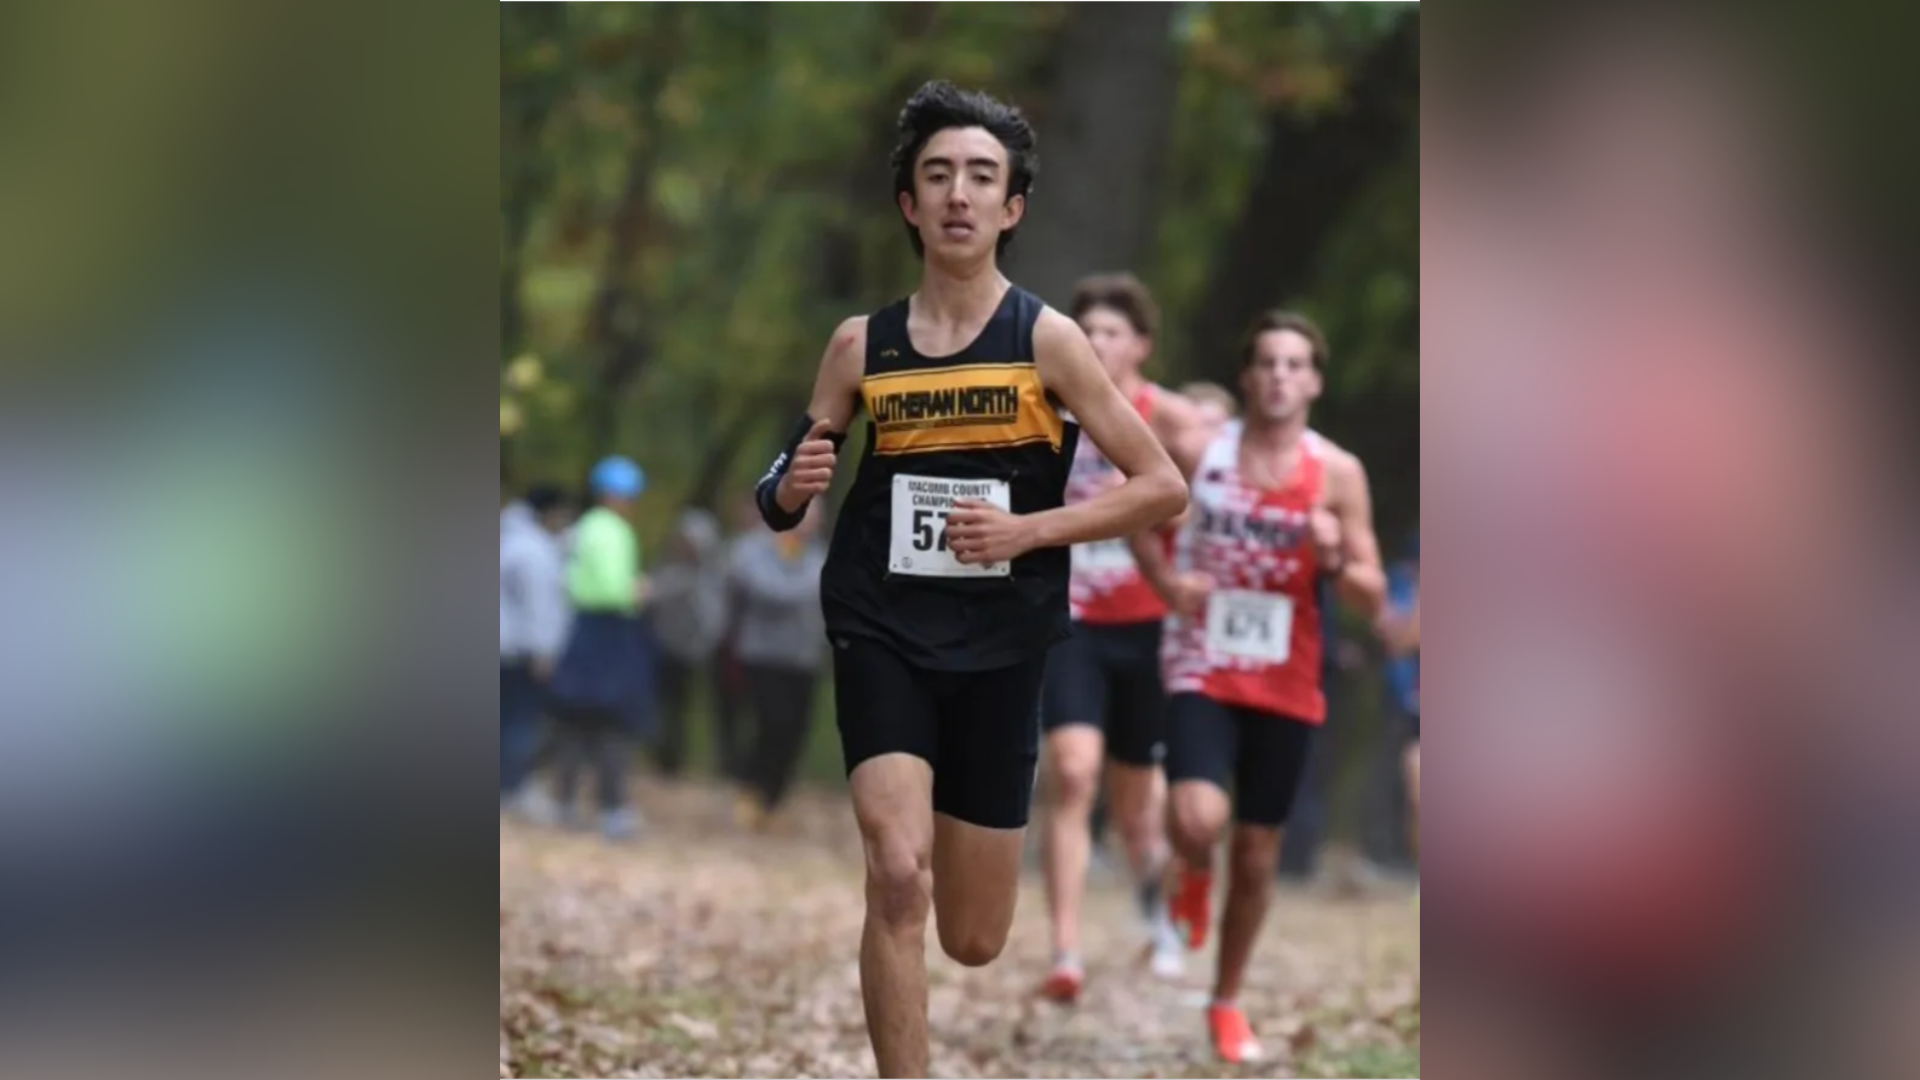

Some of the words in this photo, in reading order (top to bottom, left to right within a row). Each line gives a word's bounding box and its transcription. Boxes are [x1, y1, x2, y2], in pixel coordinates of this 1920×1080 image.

[873, 388, 956, 423] LUTHERAN
[957, 385, 1018, 415] NORTH
[908, 481, 950, 495] MACOMB
[952, 483, 991, 496] COUNTY
[912, 509, 948, 552] 57
